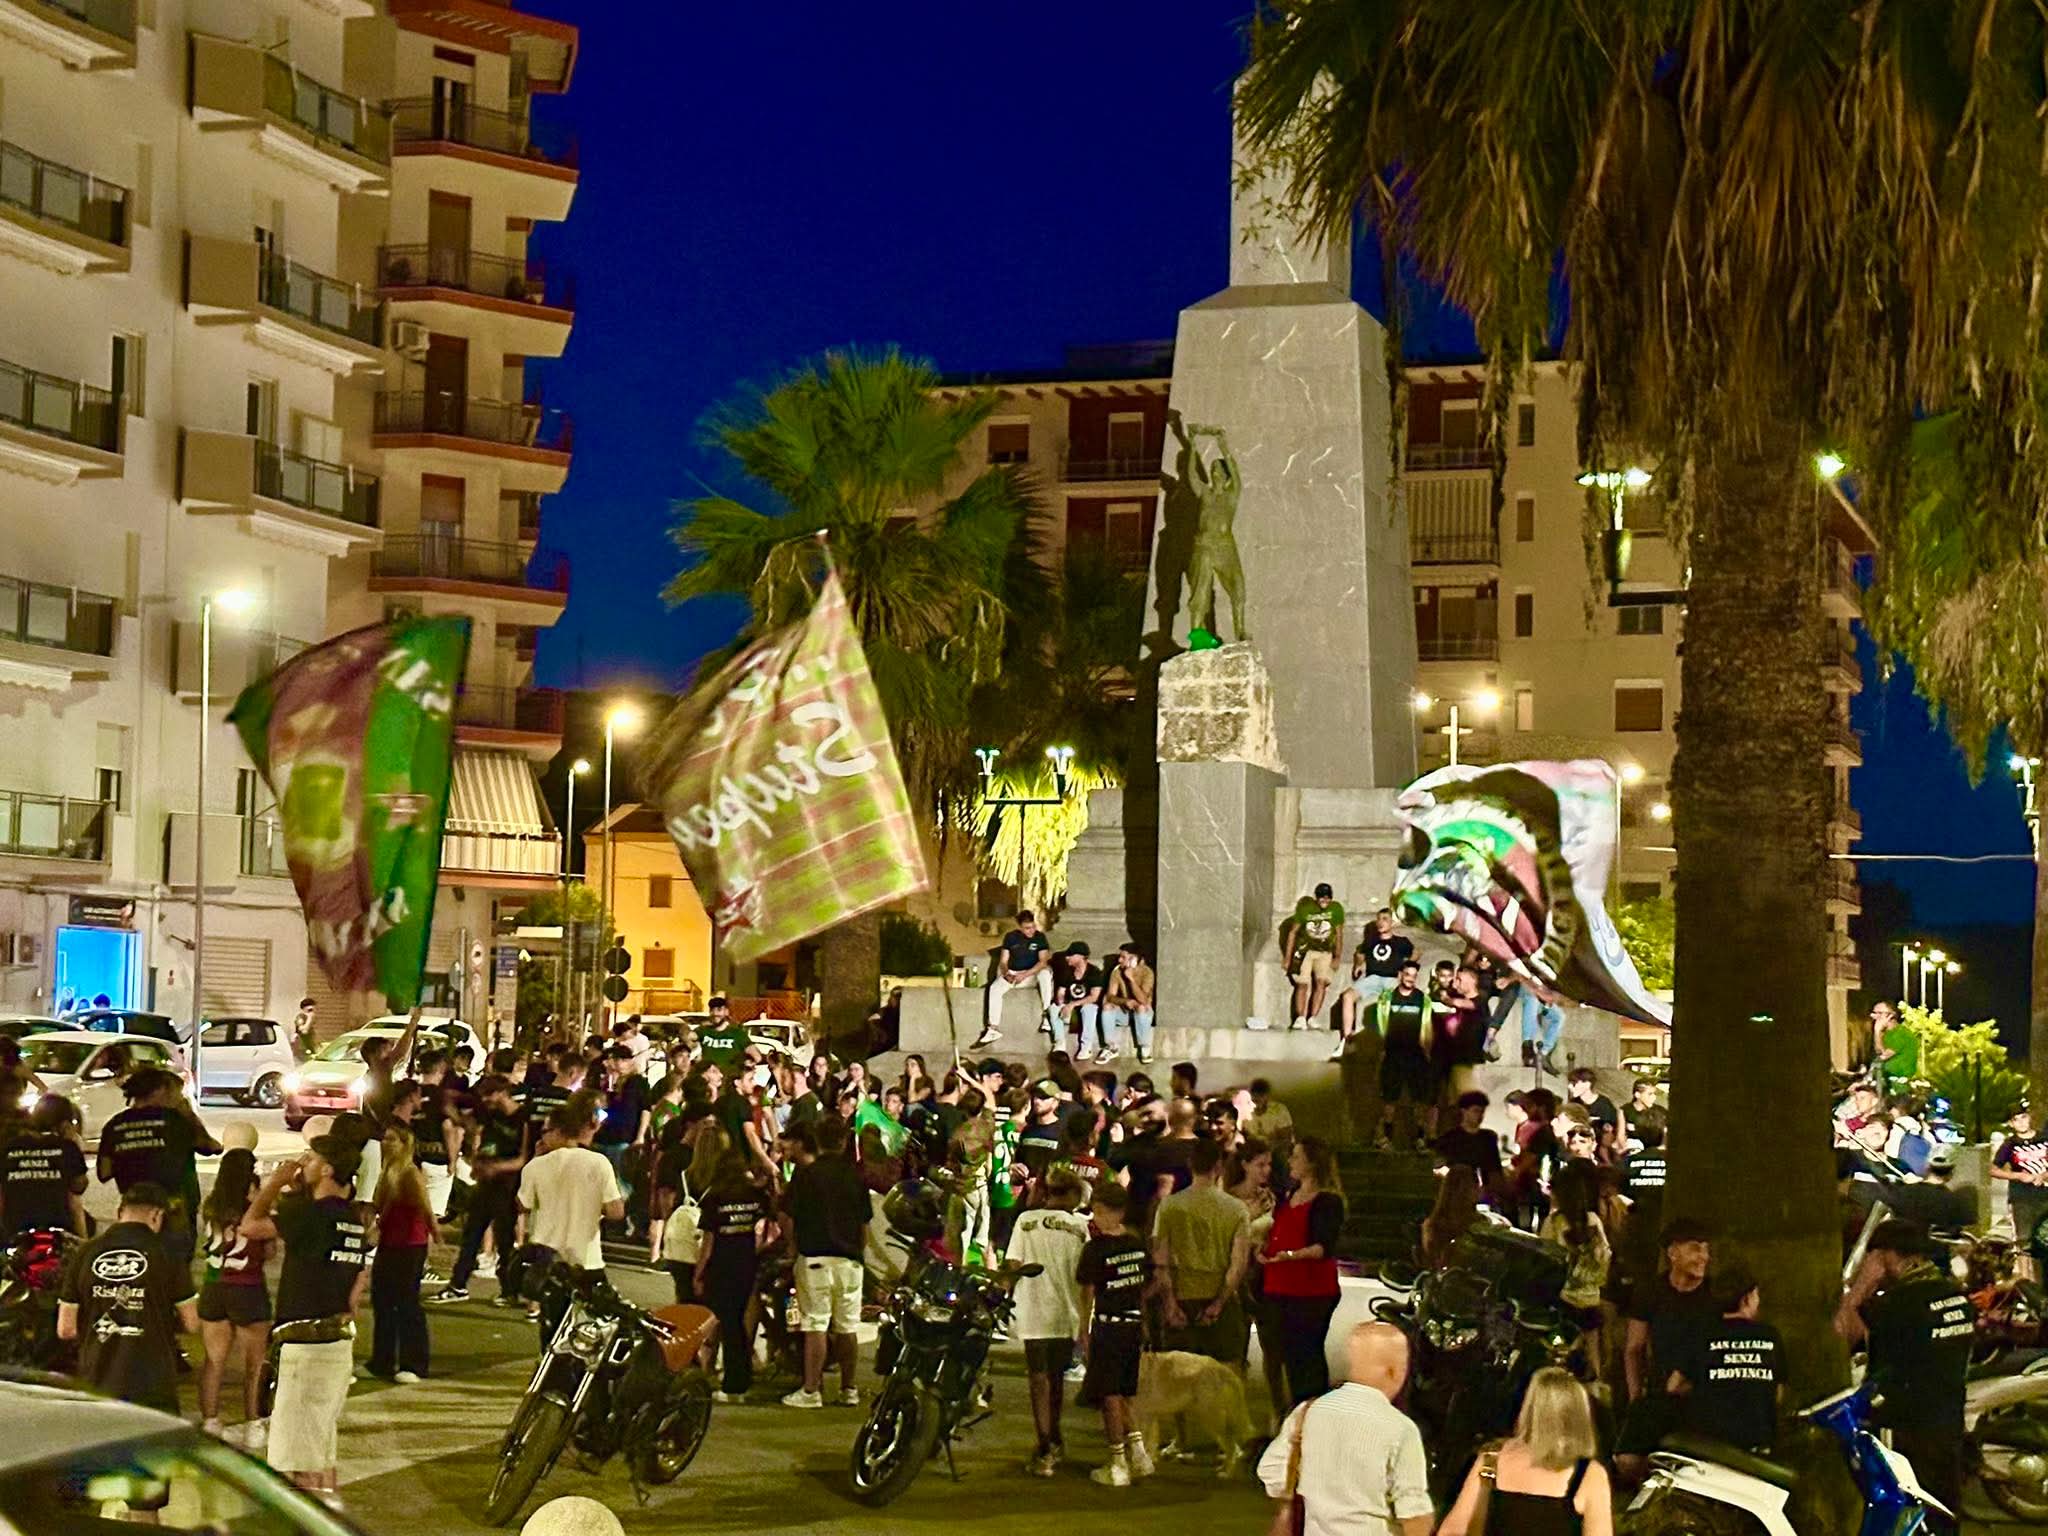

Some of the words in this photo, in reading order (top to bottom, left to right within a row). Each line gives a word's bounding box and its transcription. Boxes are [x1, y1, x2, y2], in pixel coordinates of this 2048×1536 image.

[1710, 1341, 1729, 1350] SAN
[1731, 1341, 1774, 1350] CATALDO
[1724, 1353, 1762, 1364] SENZA
[1709, 1368, 1773, 1380] PROVINCIA
